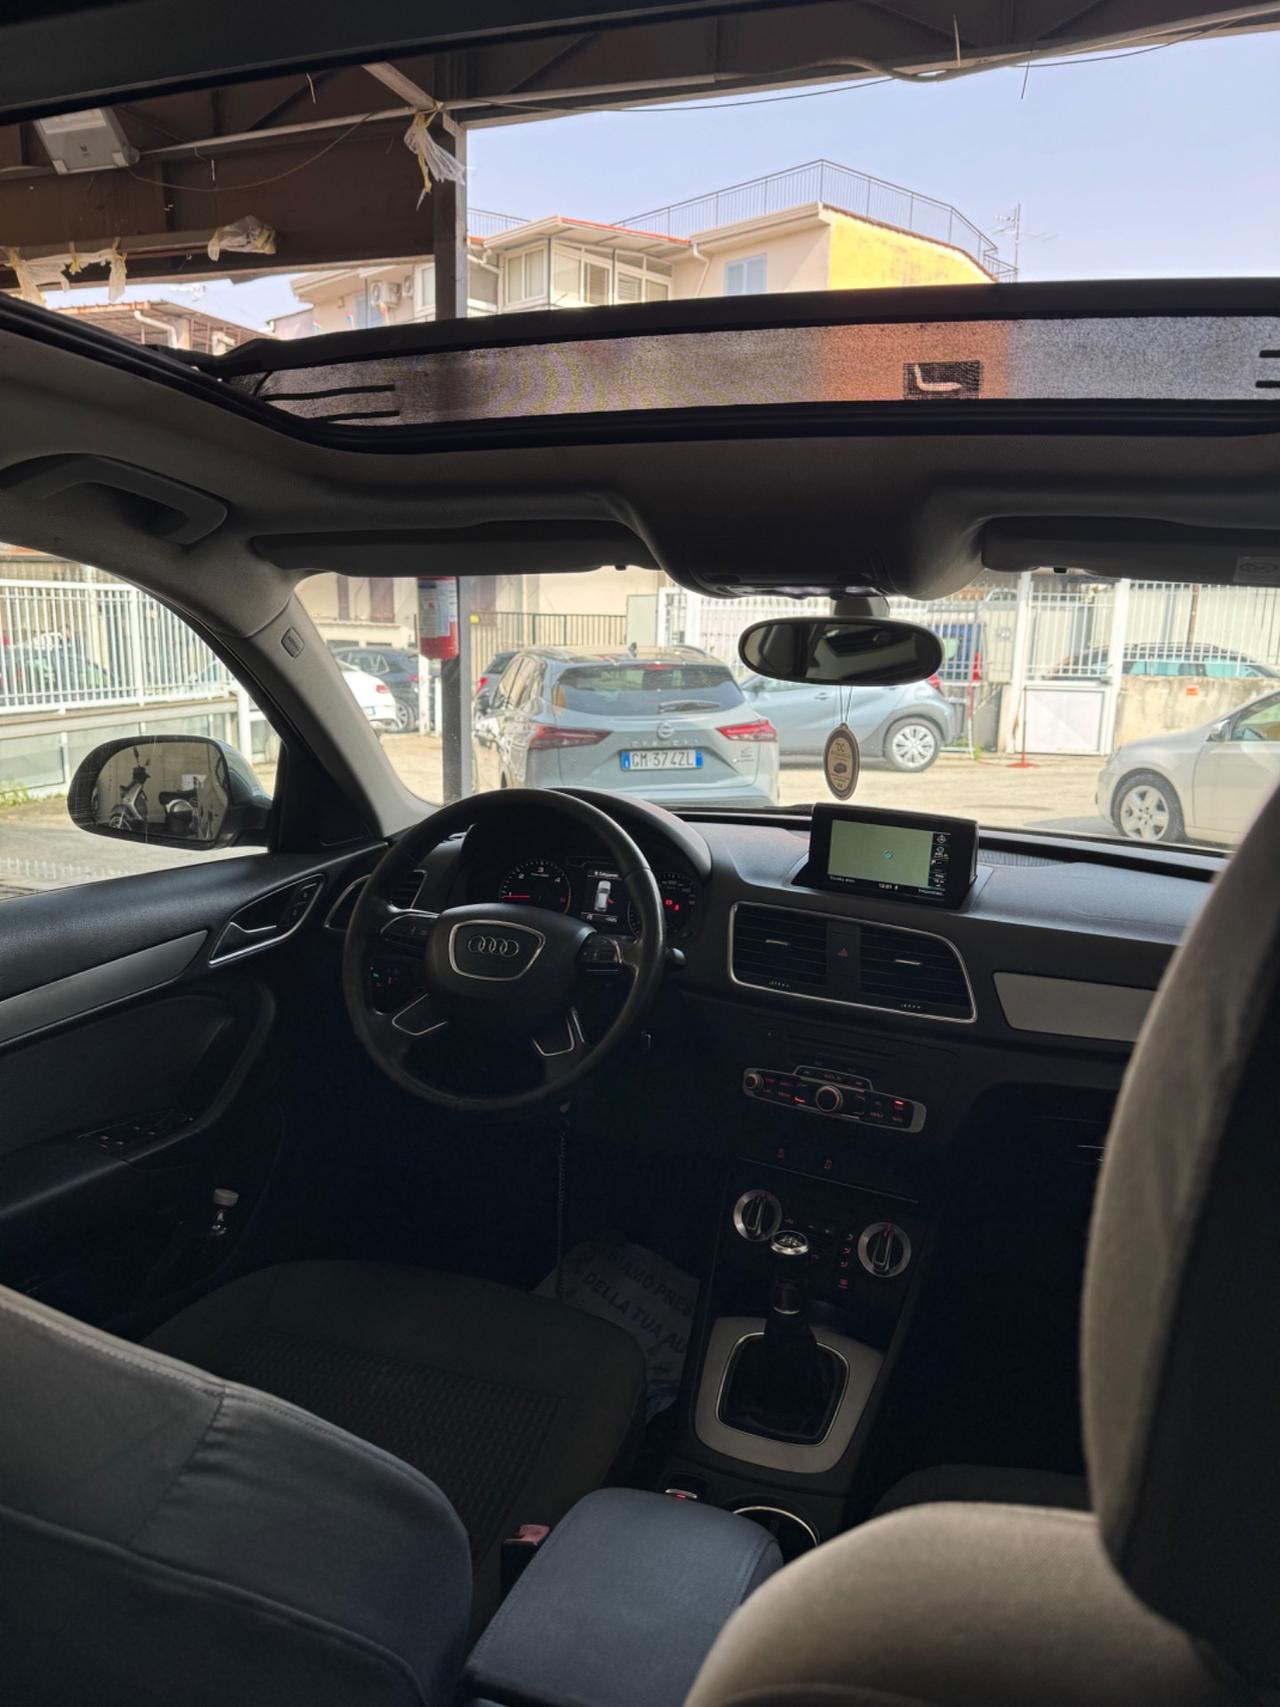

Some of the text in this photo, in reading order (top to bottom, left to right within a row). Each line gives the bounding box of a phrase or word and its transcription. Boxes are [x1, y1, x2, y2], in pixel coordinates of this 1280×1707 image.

[631, 752, 648, 767] GM
[582, 1271, 632, 1315] DELLA
[632, 1306, 664, 1338] TUA
